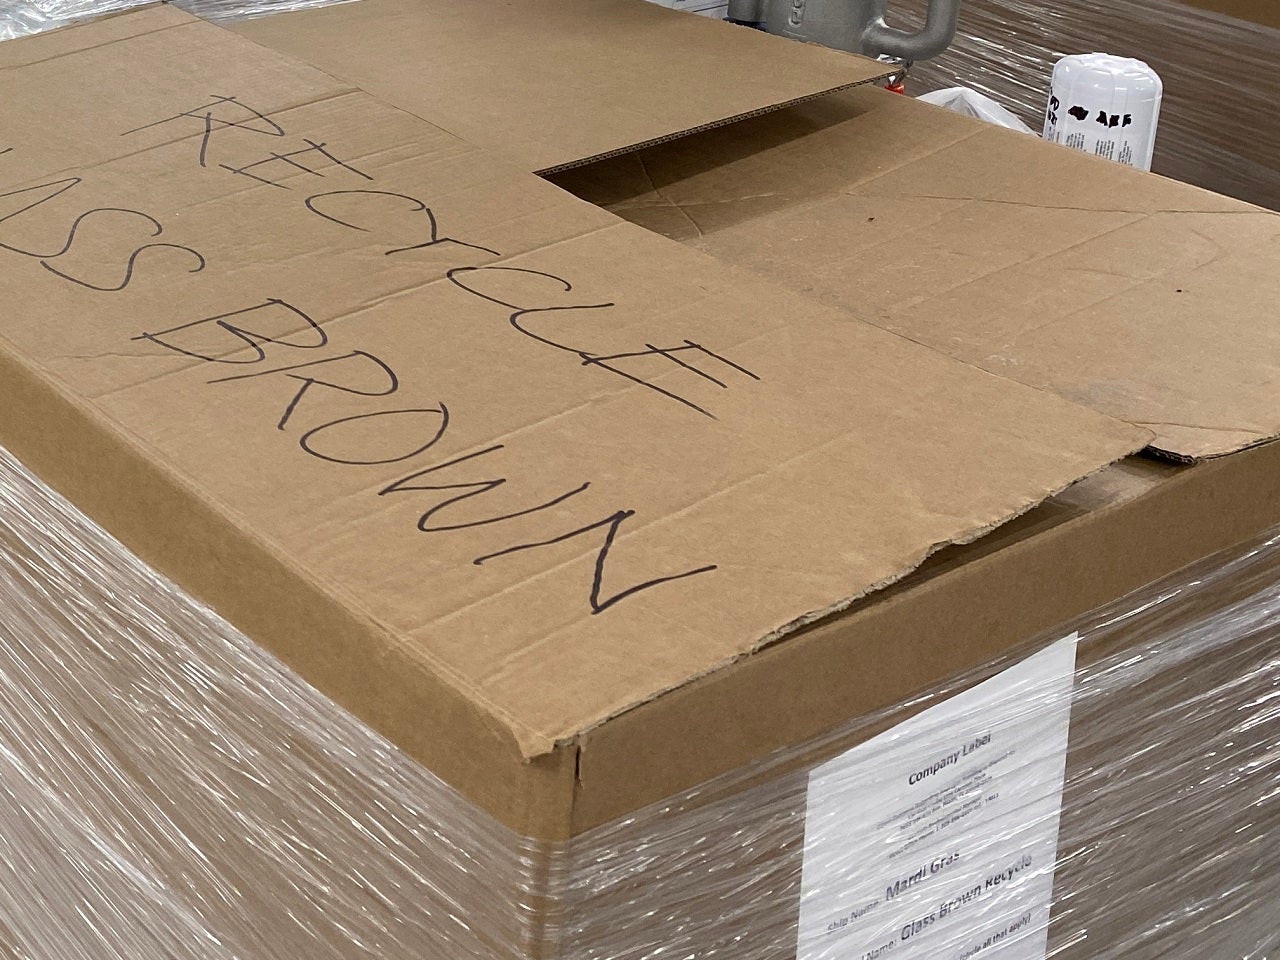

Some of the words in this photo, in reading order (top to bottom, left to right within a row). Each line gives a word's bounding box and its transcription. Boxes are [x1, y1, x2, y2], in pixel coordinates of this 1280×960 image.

[180, 94, 760, 418] RECYCLE
[132, 298, 717, 615] BROWN
[909, 750, 960, 785] Company
[962, 731, 991, 756] Label
[885, 868, 927, 901] Mardi
[930, 851, 959, 873] Gras
[901, 916, 935, 941] Glass
[939, 884, 981, 918] Brown
[985, 855, 1032, 890] Recycle
[982, 937, 992, 948] all
[993, 931, 1008, 944] that
[1009, 914, 1031, 933] apply)
